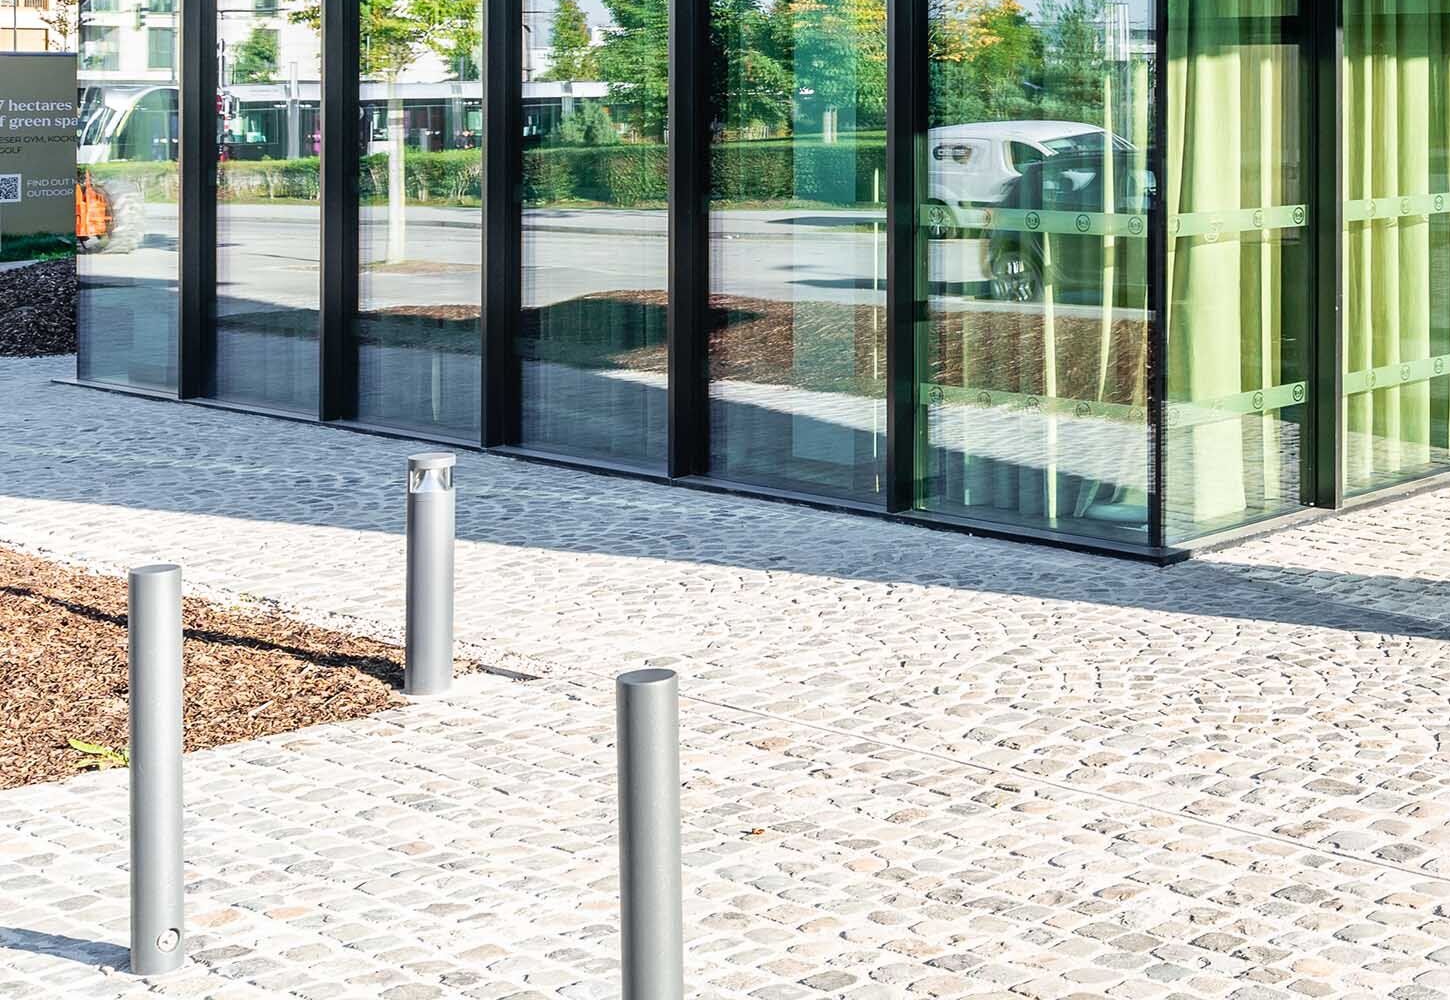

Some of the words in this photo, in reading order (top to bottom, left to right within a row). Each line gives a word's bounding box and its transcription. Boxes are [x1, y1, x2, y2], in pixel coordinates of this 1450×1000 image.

[9, 100, 73, 111] hectares
[9, 117, 51, 129] green
[26, 179, 49, 187] FIND
[50, 178, 70, 186] OUT
